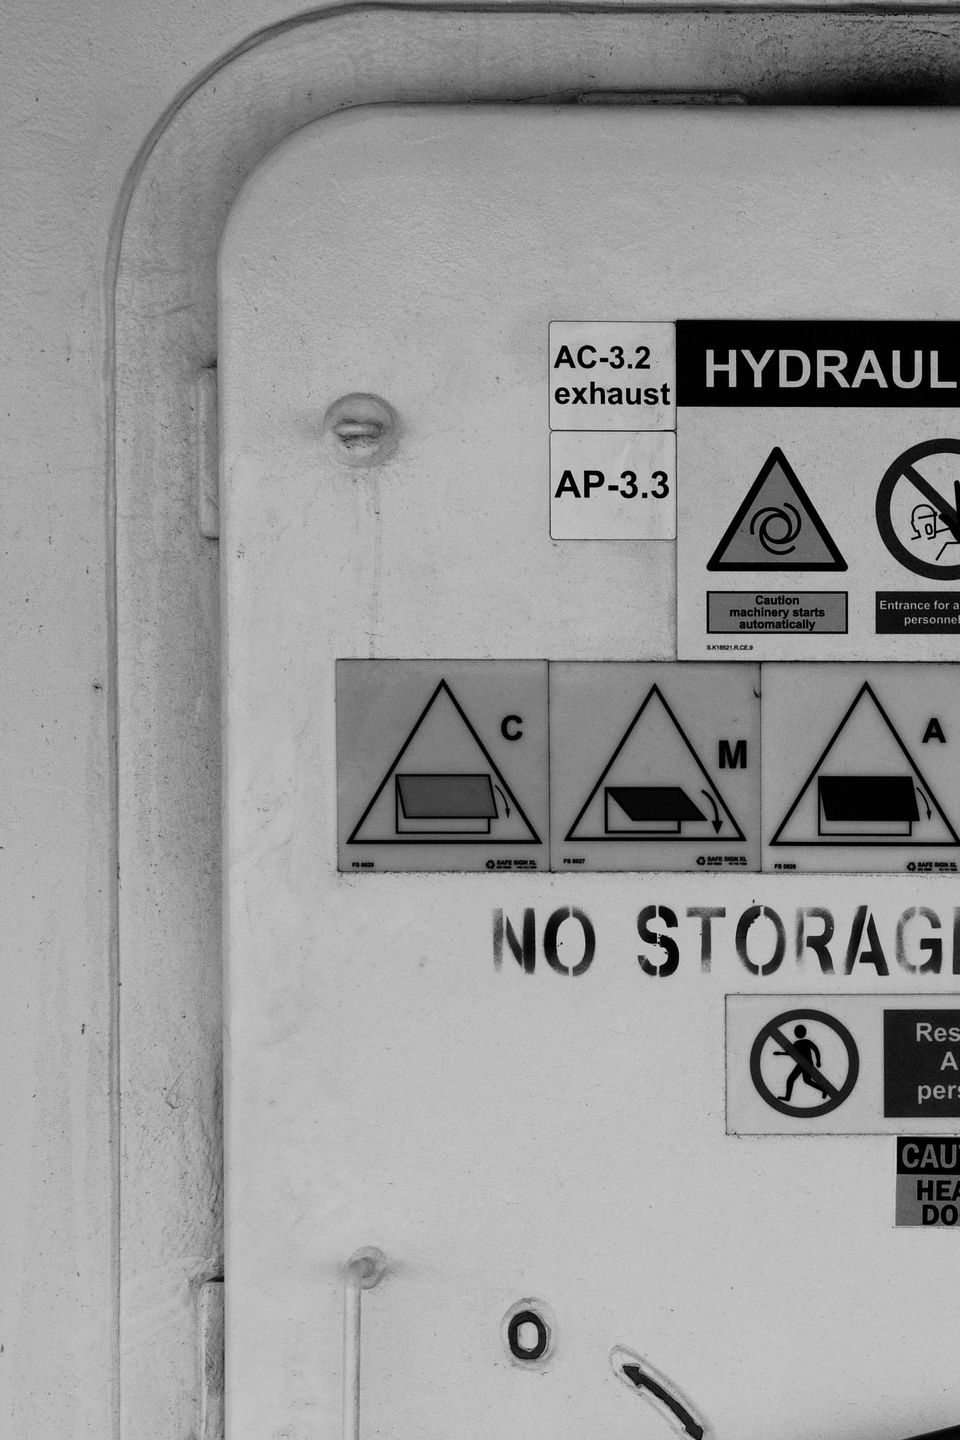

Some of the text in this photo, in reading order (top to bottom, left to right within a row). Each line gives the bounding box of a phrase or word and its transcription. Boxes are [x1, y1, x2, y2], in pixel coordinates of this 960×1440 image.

[554, 345, 650, 369] AC-3.2
[555, 381, 670, 405] exhaust
[555, 470, 669, 499] AP-3.3
[755, 595, 799, 605] Caution
[880, 600, 930, 609] Entrance
[934, 601, 949, 609] for
[730, 607, 825, 619] machinery starts
[739, 619, 815, 631] automatically
[905, 615, 960, 626] personnel
[501, 715, 523, 741] C
[922, 718, 946, 743] A
[719, 740, 747, 769] M
[494, 908, 595, 976] NO
